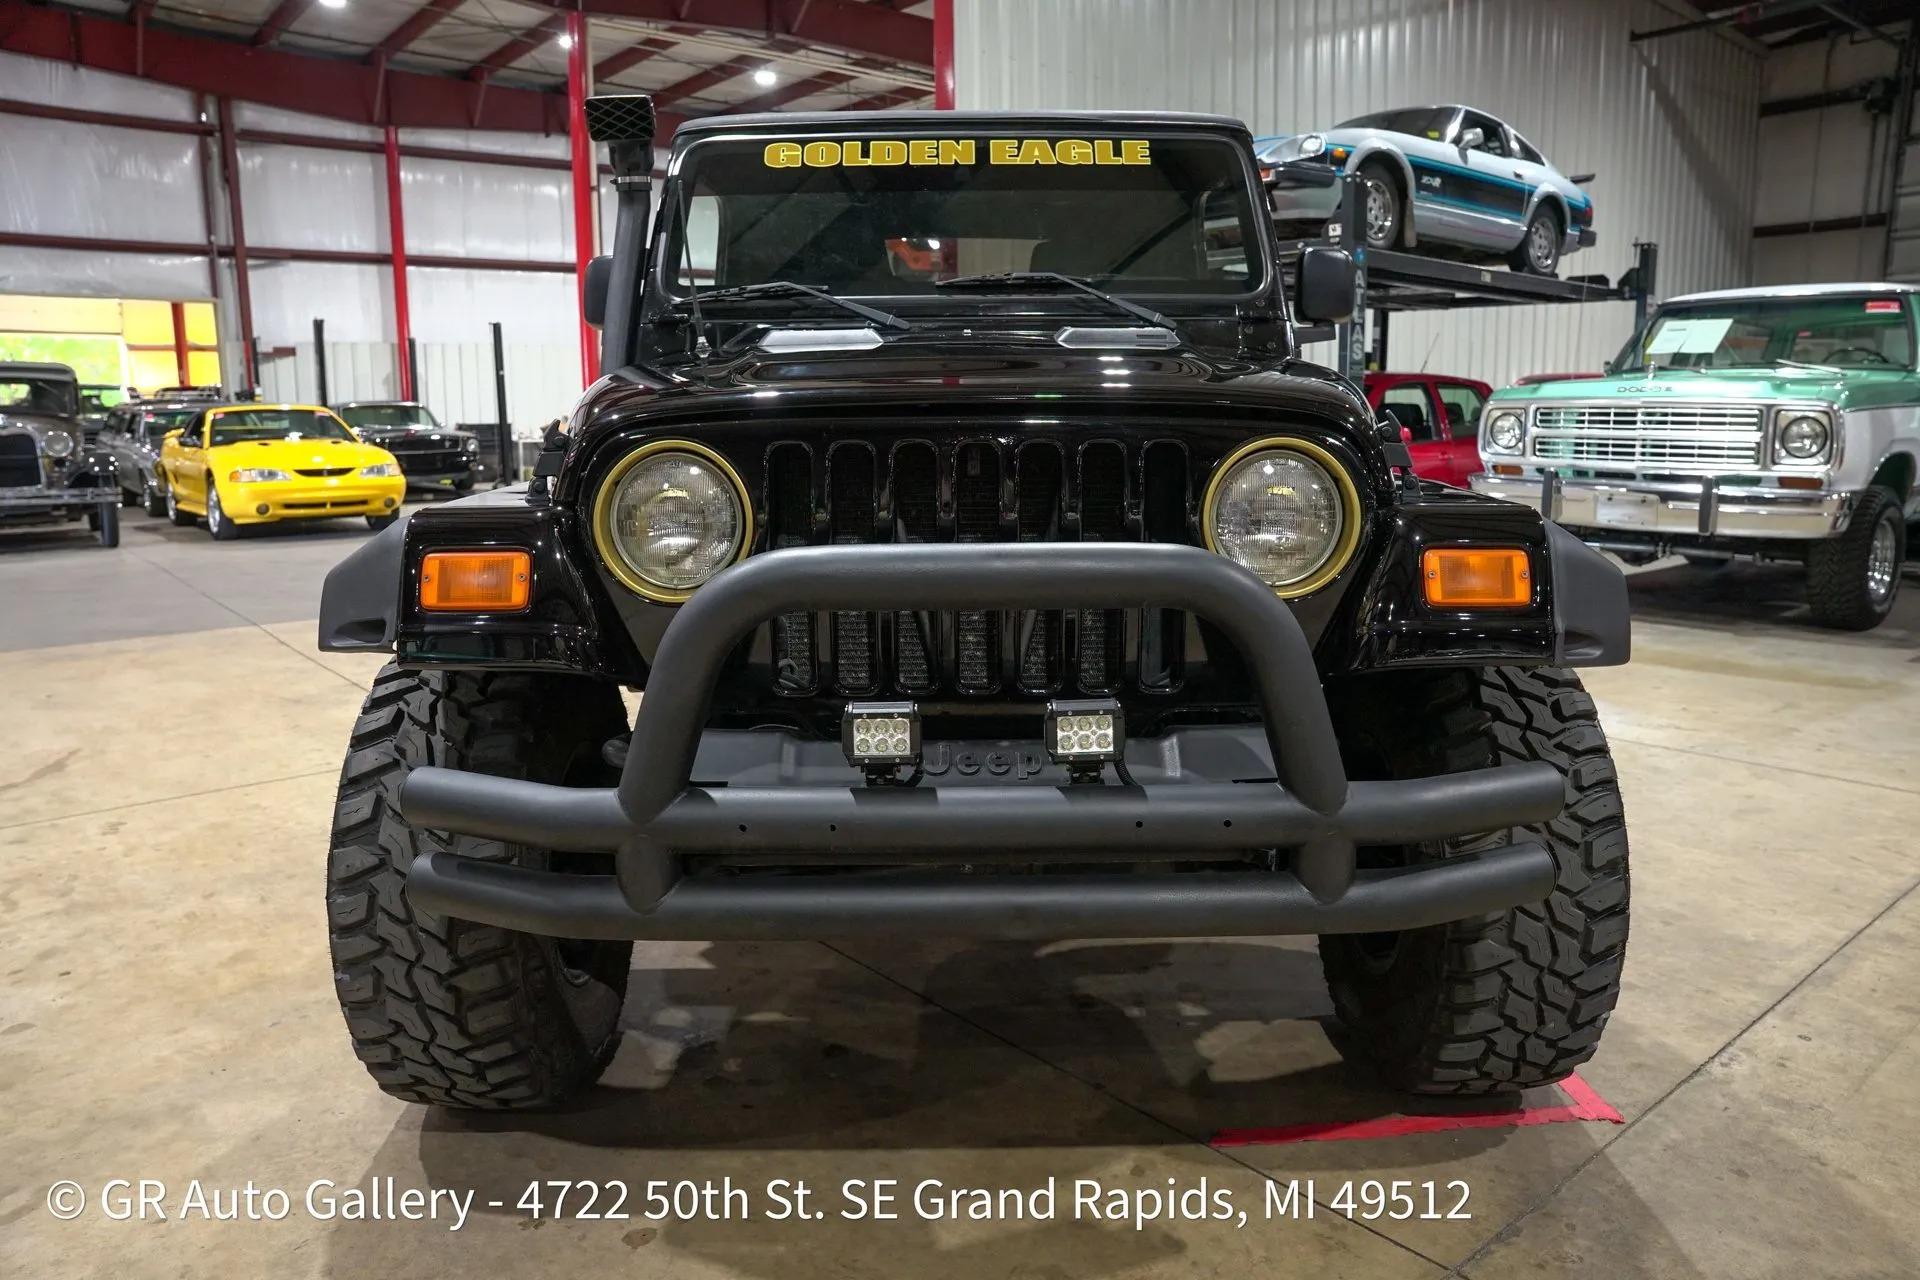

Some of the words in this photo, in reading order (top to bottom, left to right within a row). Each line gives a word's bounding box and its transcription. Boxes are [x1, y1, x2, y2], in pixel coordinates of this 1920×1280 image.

[763, 139, 976, 169] GOLDEN
[989, 139, 1152, 166] EAGLE
[1352, 268, 1366, 361] ATLAS
[923, 744, 1043, 780] Jeep
